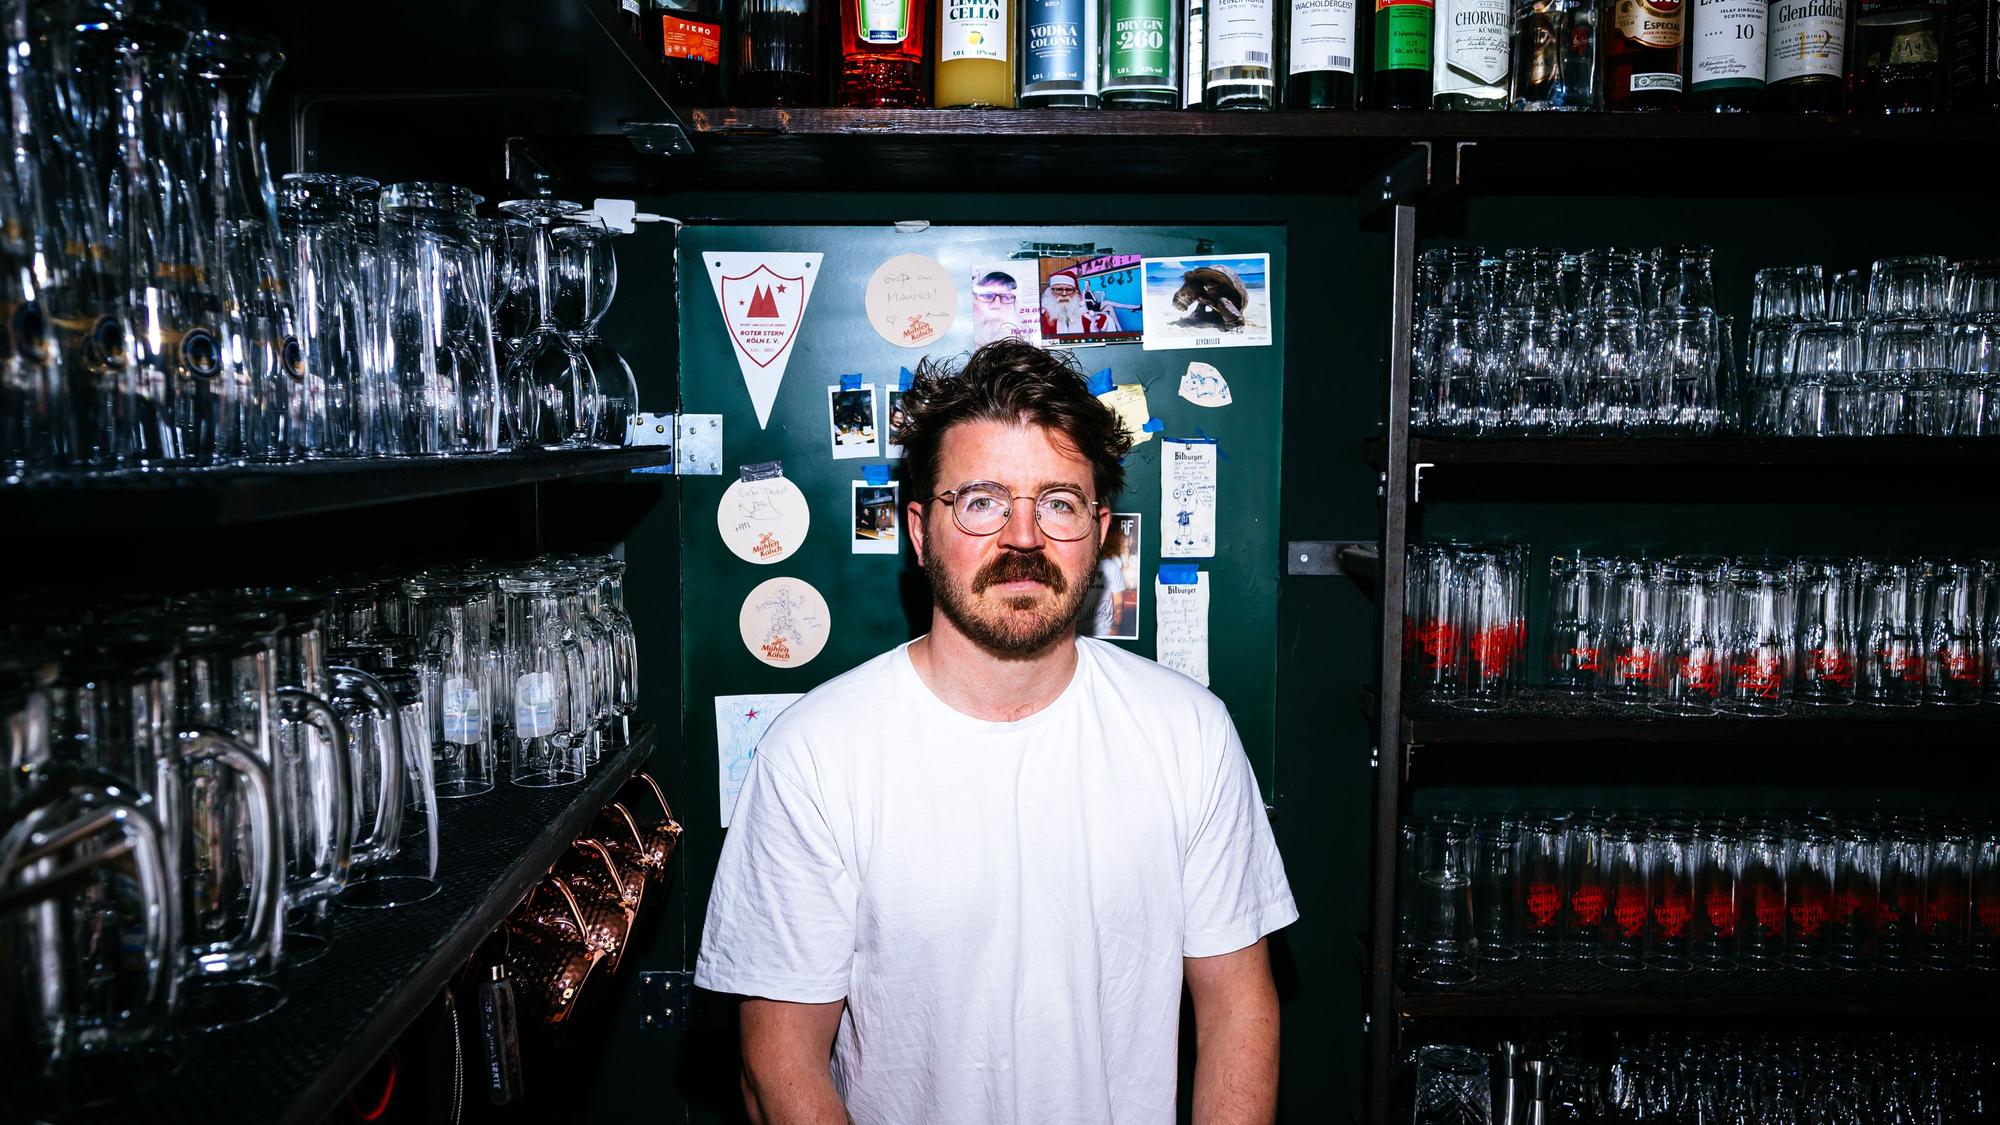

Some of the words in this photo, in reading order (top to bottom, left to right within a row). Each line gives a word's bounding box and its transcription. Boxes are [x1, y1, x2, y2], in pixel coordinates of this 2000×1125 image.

[1295, 0, 1353, 10] WACHOLDERGEIST
[949, 7, 1000, 20] CELLO
[1778, 0, 1844, 24] Glenfiddich
[679, 23, 711, 35] FIERO
[1030, 24, 1078, 38] VODKA
[1116, 21, 1139, 32] DRY
[1143, 19, 1163, 31] GIN
[1643, 20, 1681, 31] ESPECIAL
[1735, 24, 1755, 39] 10
[1030, 37, 1078, 49] COLONIA
[1120, 30, 1163, 49] 260
[1174, 451, 1203, 461] Bitburger
[1167, 585, 1197, 595] Bitburger
